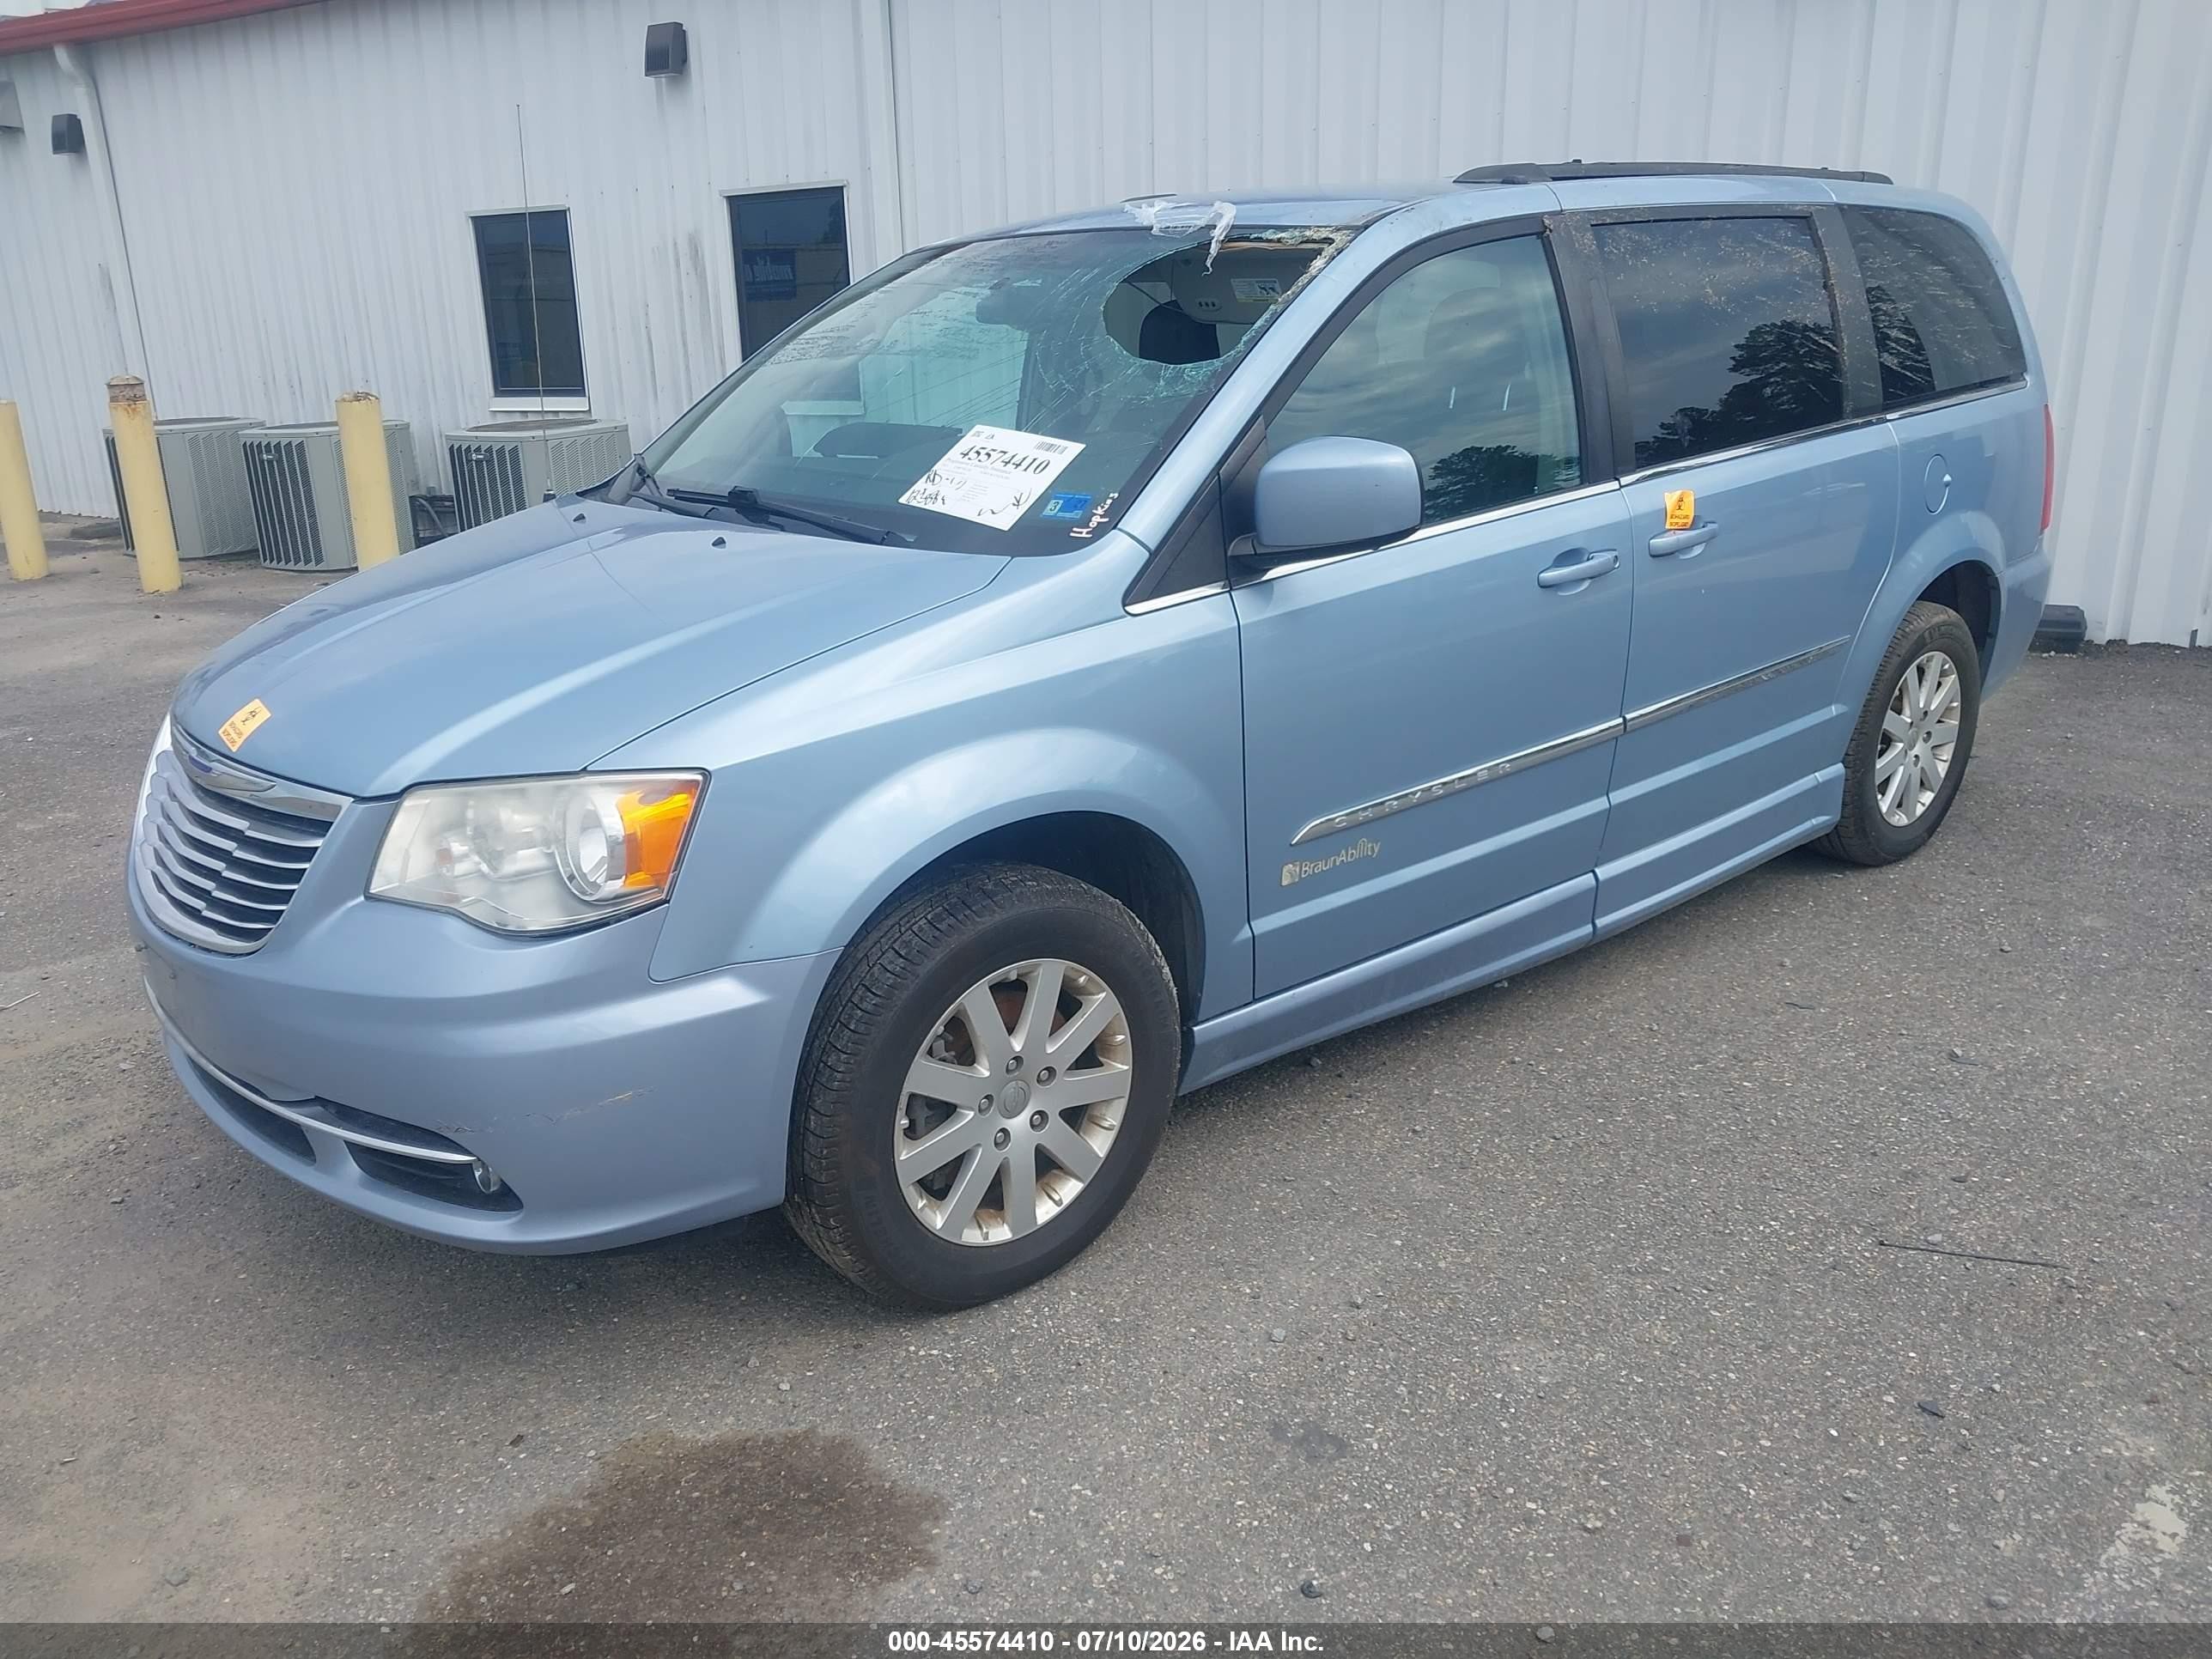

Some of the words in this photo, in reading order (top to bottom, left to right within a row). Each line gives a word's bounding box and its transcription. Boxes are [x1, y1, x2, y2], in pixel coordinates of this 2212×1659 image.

[960, 445, 1051, 475] 45574410
[1049, 501, 1060, 512] 3
[1334, 763, 1511, 828] CHRYSLER
[1301, 837, 1381, 878] BraunAbility
